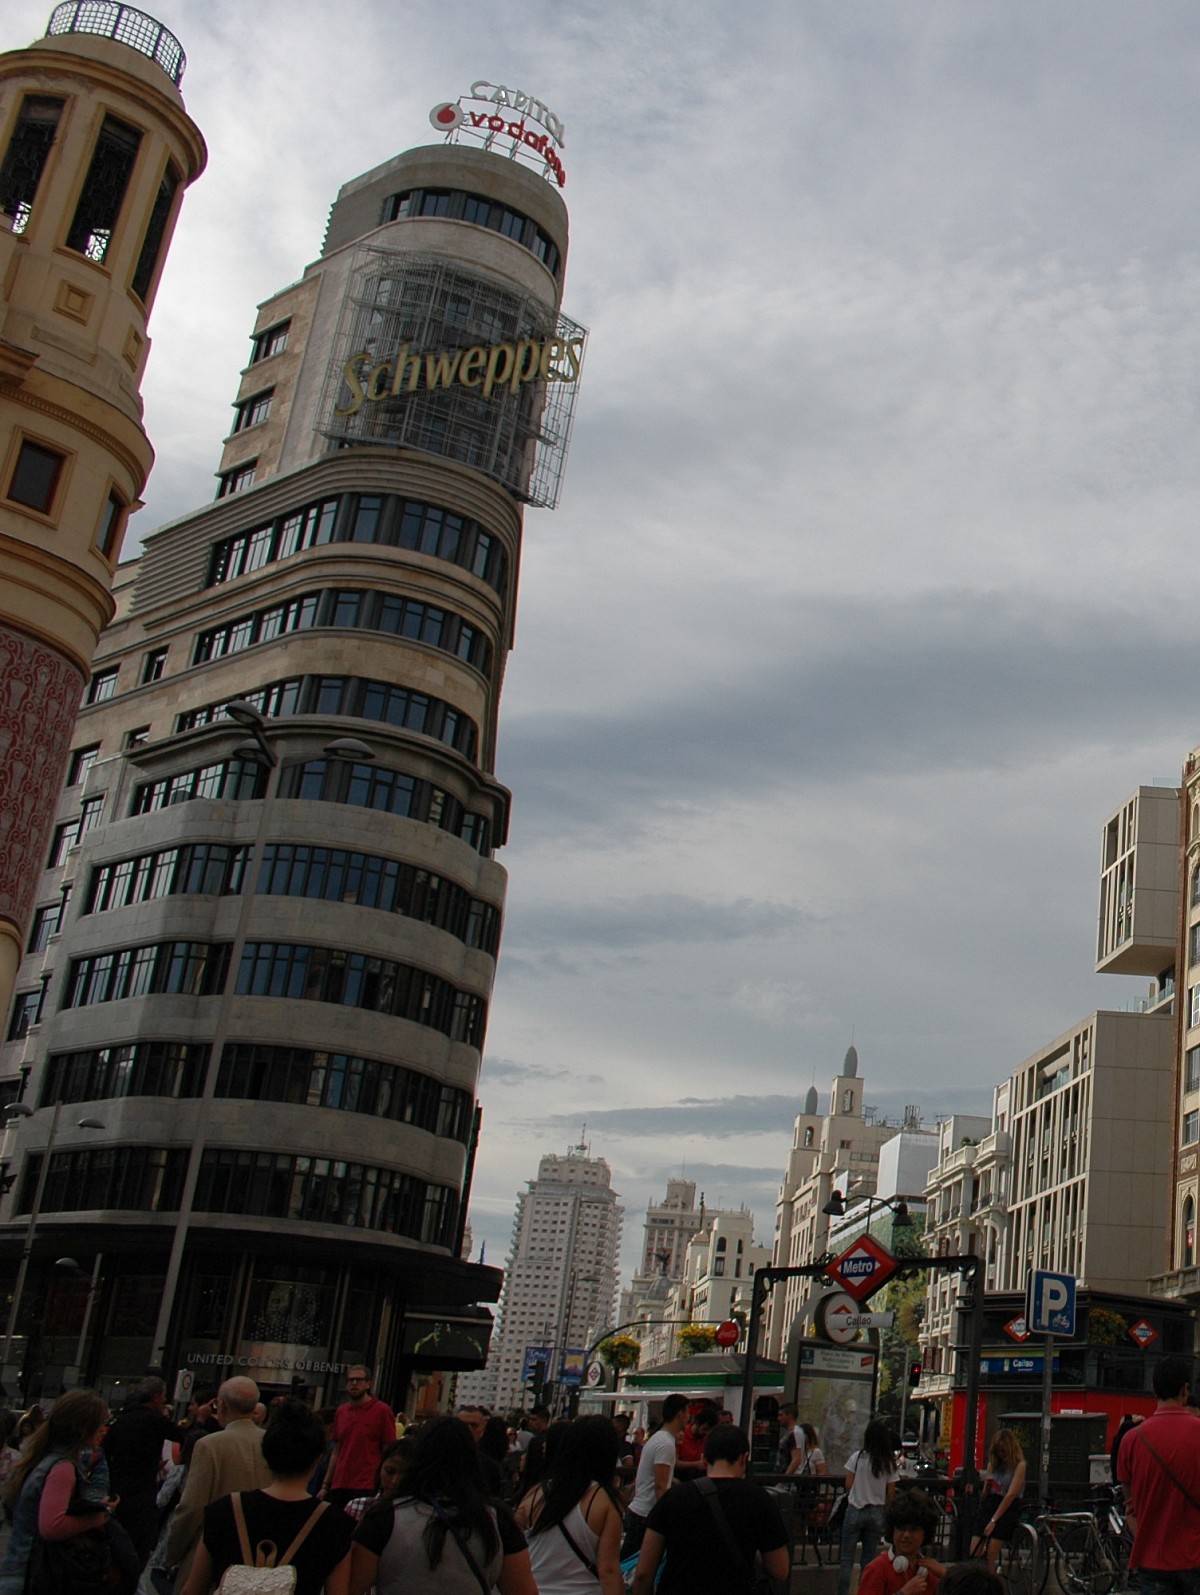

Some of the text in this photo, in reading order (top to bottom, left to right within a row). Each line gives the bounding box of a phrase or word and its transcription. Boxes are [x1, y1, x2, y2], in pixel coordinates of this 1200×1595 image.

[470, 80, 565, 149] CAPITOL
[469, 111, 566, 188] vodafone
[334, 337, 583, 416] Schweppes
[843, 1260, 873, 1274] Metro
[846, 1316, 871, 1326] Callao
[1040, 1278, 1068, 1327] P
[187, 1353, 234, 1366] UNITED
